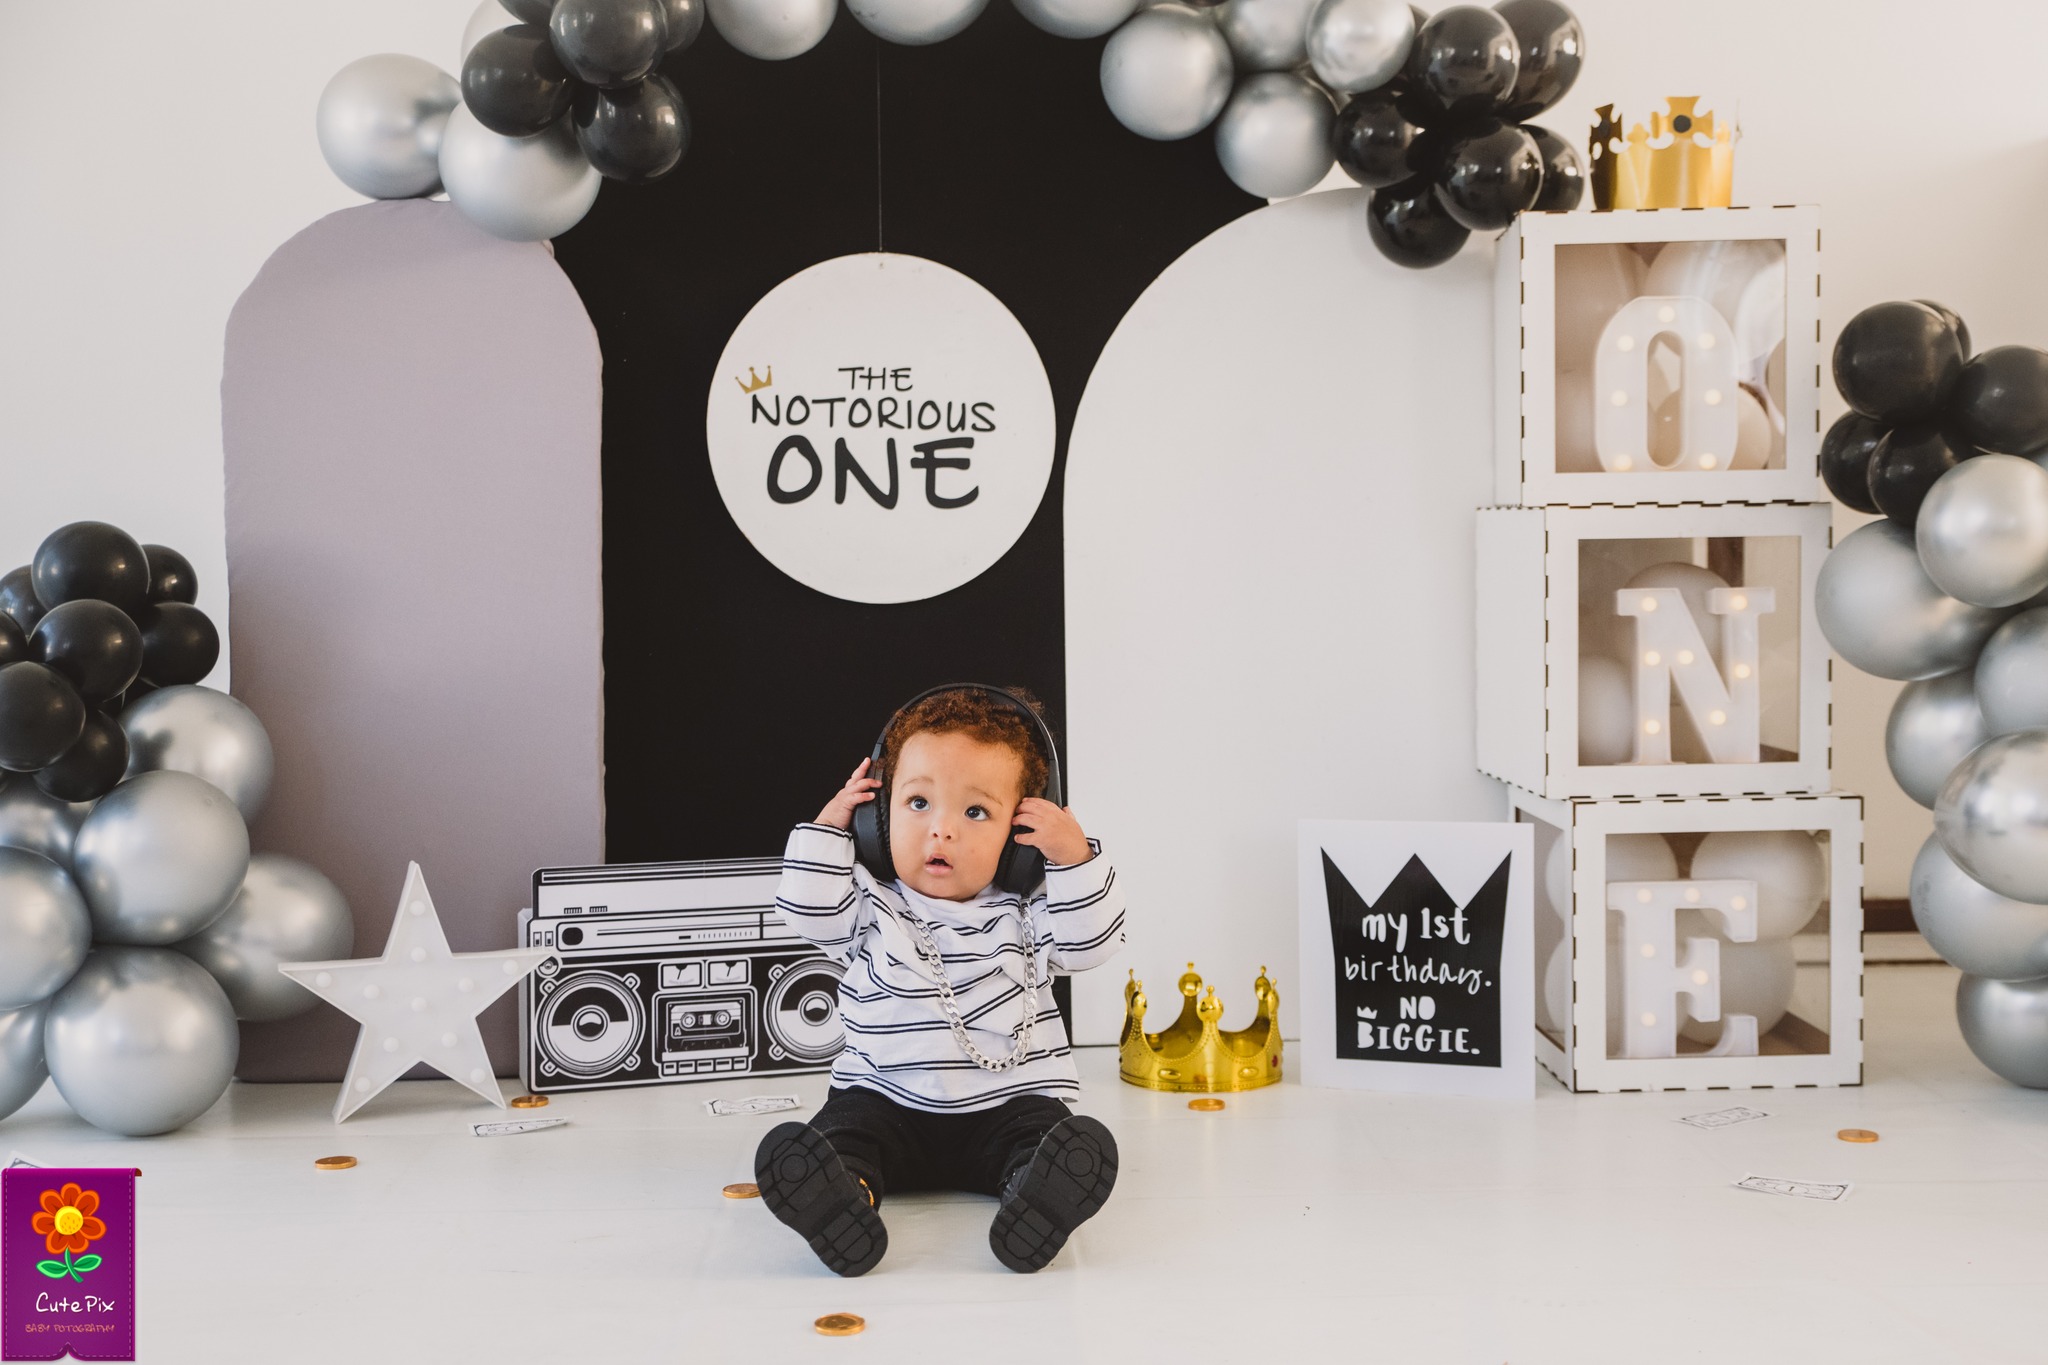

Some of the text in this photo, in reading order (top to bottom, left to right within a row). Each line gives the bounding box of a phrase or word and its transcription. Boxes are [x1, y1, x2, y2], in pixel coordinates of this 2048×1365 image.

[838, 366, 913, 391] THE
[751, 394, 996, 433] NOTORIOUS
[766, 434, 979, 510] ONE
[1362, 907, 1471, 953] my 1st
[1344, 954, 1492, 995] birthday.
[1400, 996, 1436, 1020] NO
[1357, 1021, 1480, 1055] BIGGIE.
